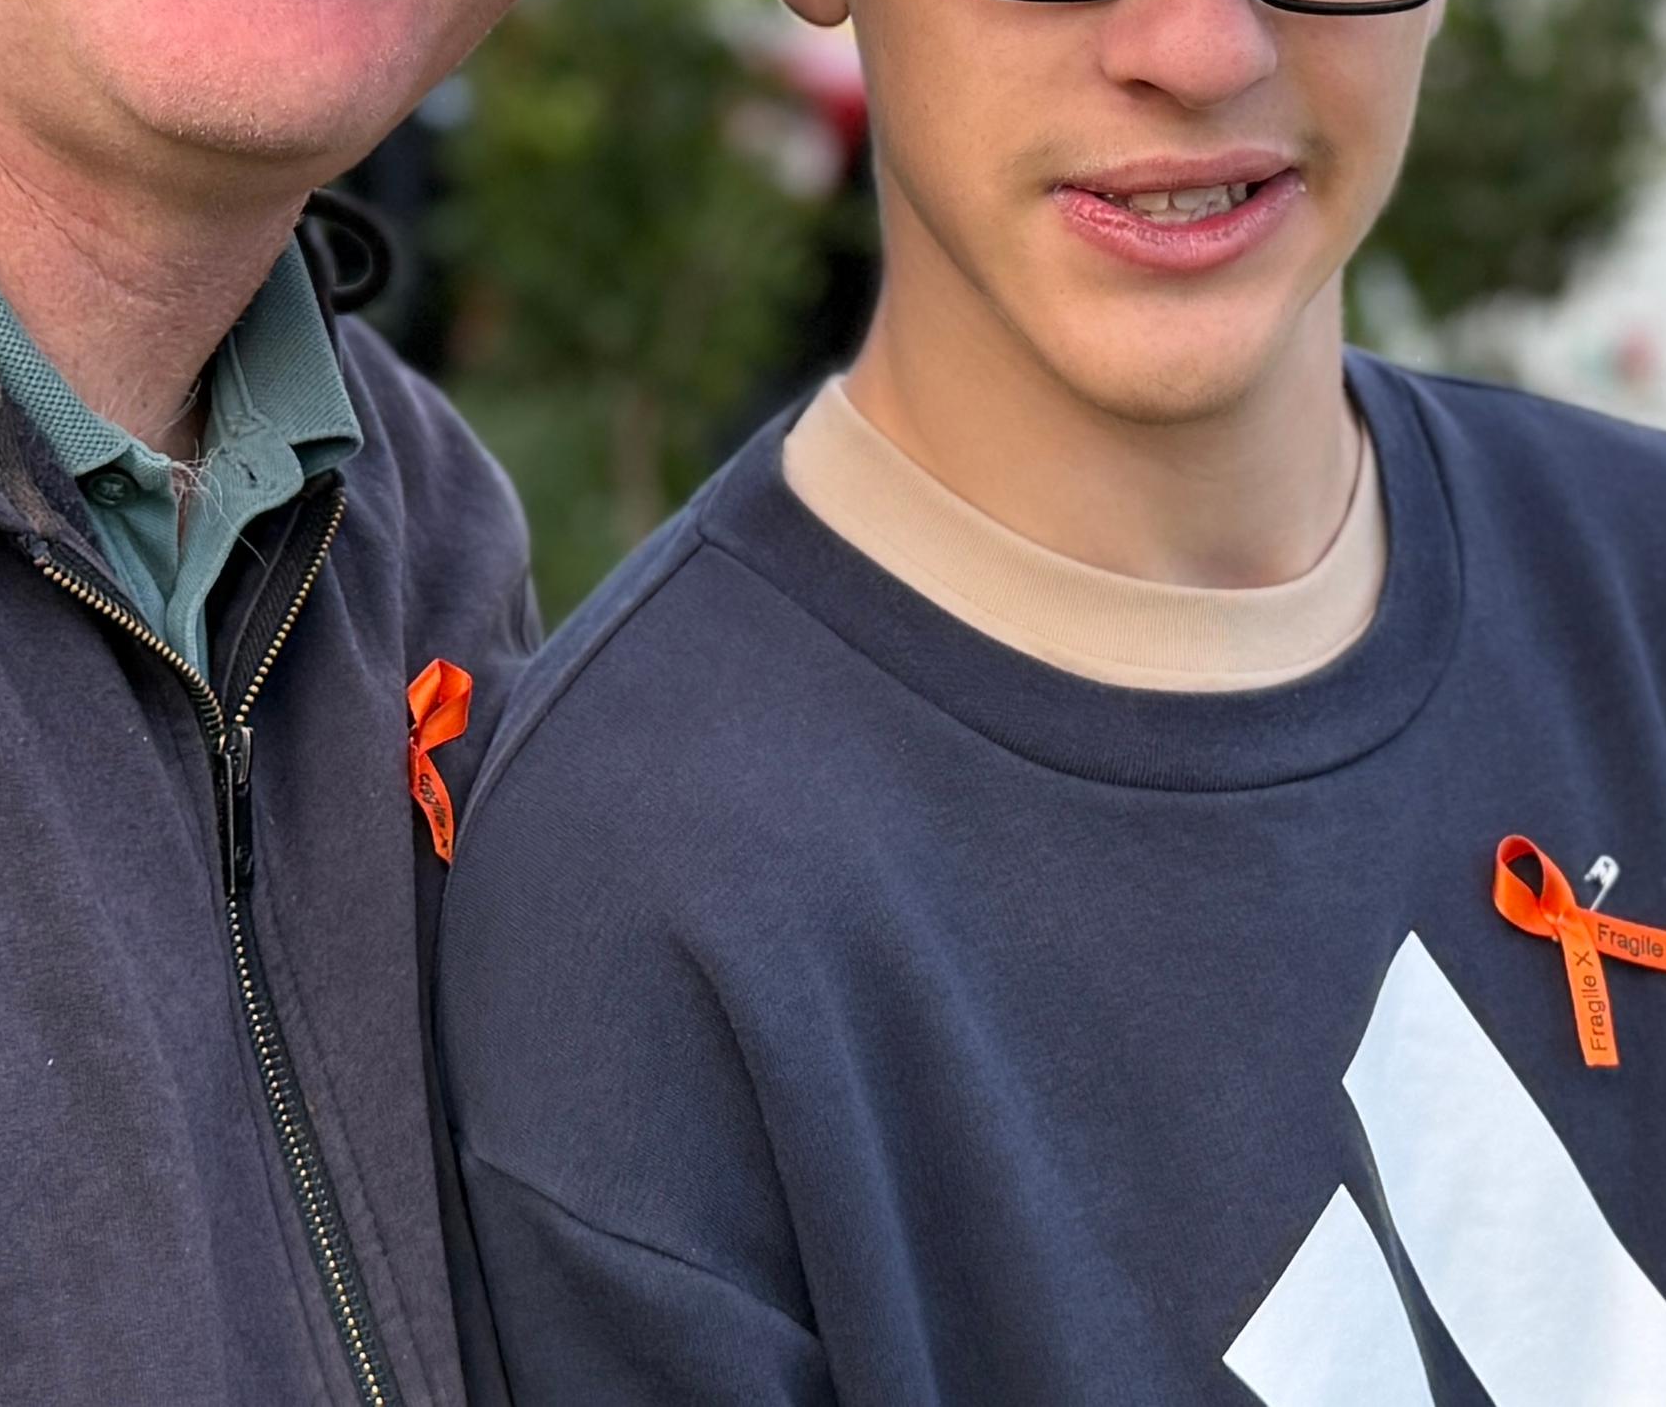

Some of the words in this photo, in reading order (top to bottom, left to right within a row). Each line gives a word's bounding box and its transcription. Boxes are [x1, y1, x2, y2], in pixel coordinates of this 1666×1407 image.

[1574, 951, 1594, 967] X
[1596, 923, 1664, 959] Fragile
[1582, 975, 1608, 1052] Fragile
